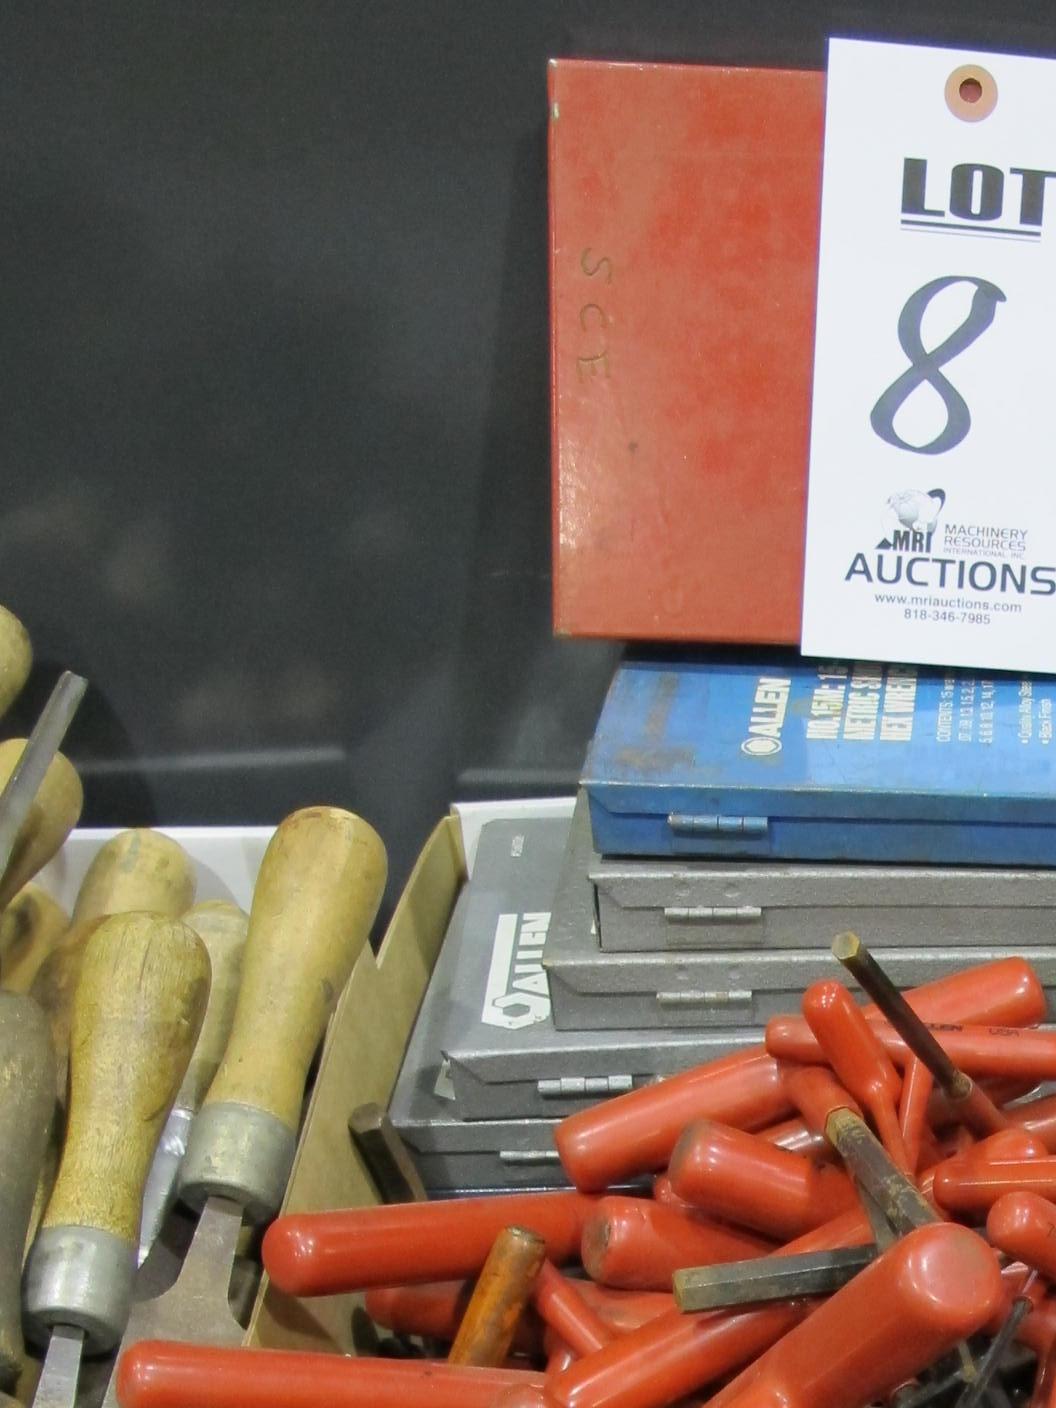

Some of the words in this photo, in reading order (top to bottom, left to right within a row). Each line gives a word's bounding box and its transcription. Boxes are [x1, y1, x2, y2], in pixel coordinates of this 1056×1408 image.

[870, 275, 1007, 455] 8
[892, 530, 933, 553] MRI
[944, 523, 1028, 540] MACHINERY
[943, 535, 1027, 552] RESOURCES
[874, 593, 1022, 613] www.mriauctions.com
[904, 608, 991, 625] 818-346-7985
[748, 678, 791, 738] ALLEN
[843, 691, 881, 741] METRIC
[880, 717, 914, 742] HEX
